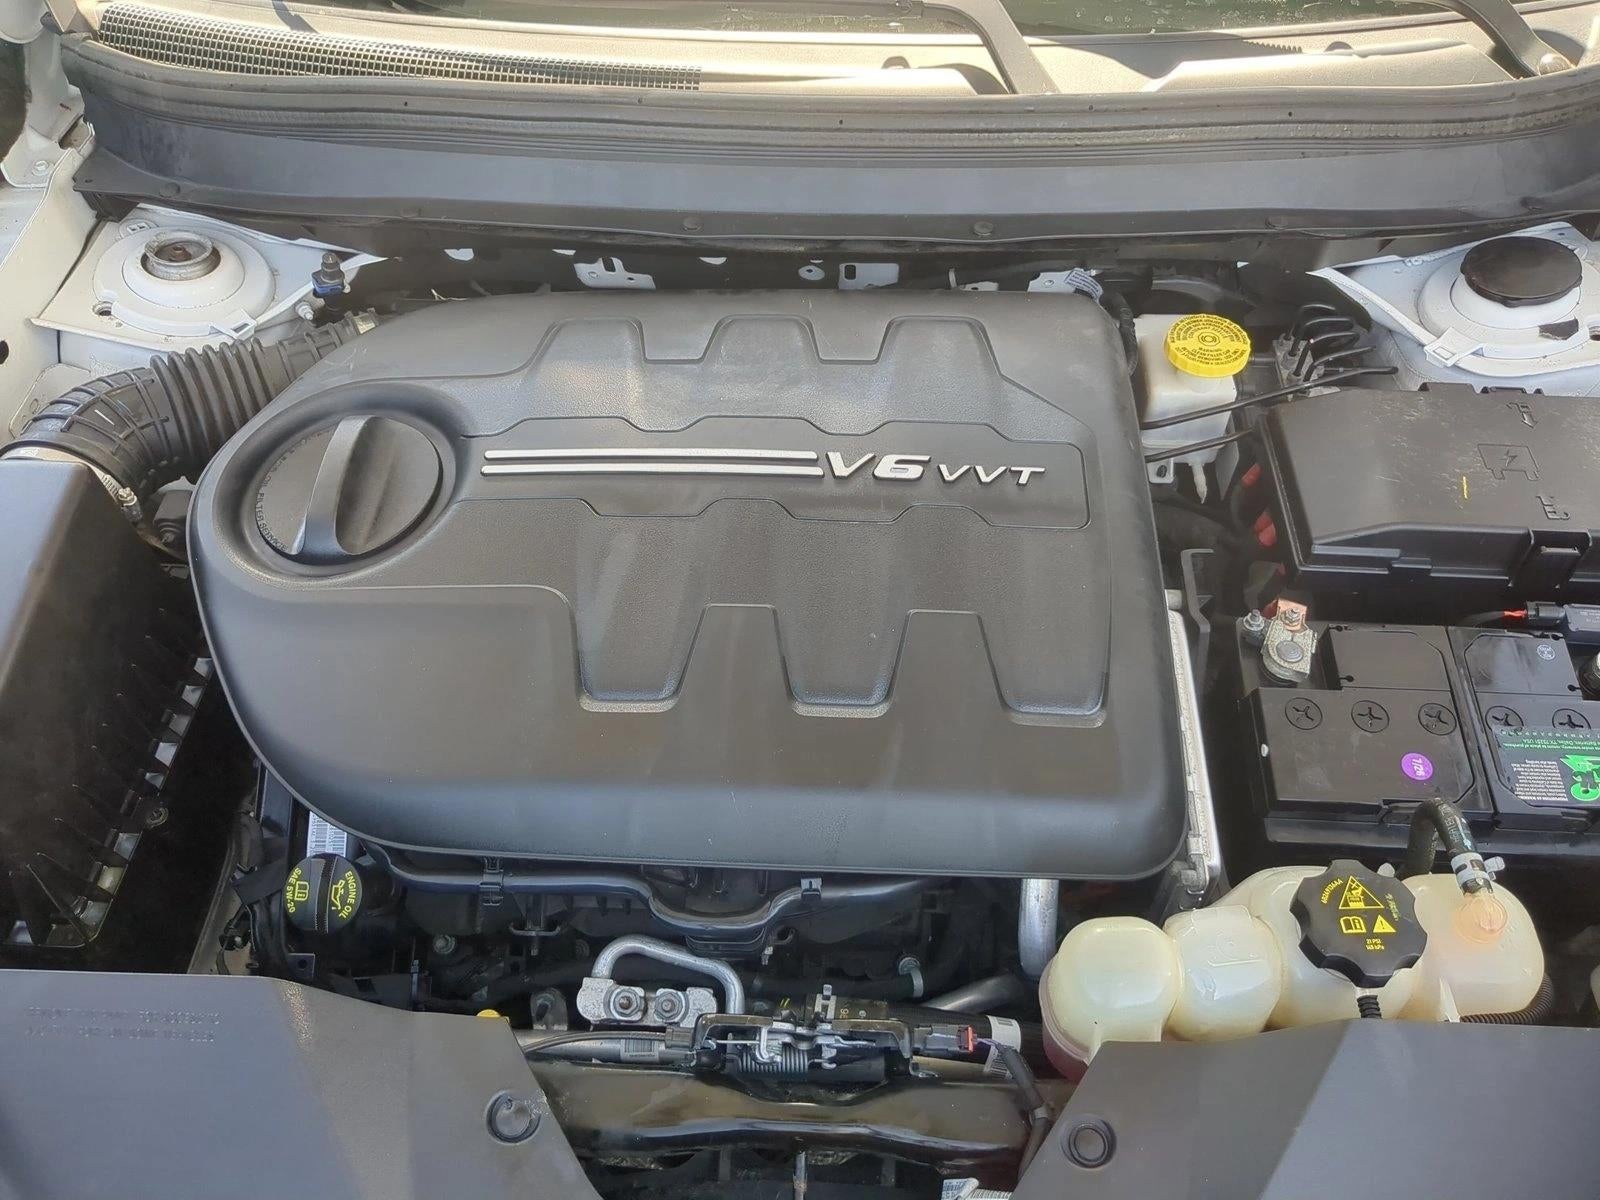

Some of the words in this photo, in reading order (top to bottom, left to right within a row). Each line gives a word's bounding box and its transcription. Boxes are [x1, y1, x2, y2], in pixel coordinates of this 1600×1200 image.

[825, 451, 932, 481] V6
[938, 464, 1046, 486] VVT
[288, 867, 302, 884] SAE
[345, 870, 356, 904] ENGINE
[286, 886, 296, 913] 5W-20
[338, 906, 352, 919] OIL
